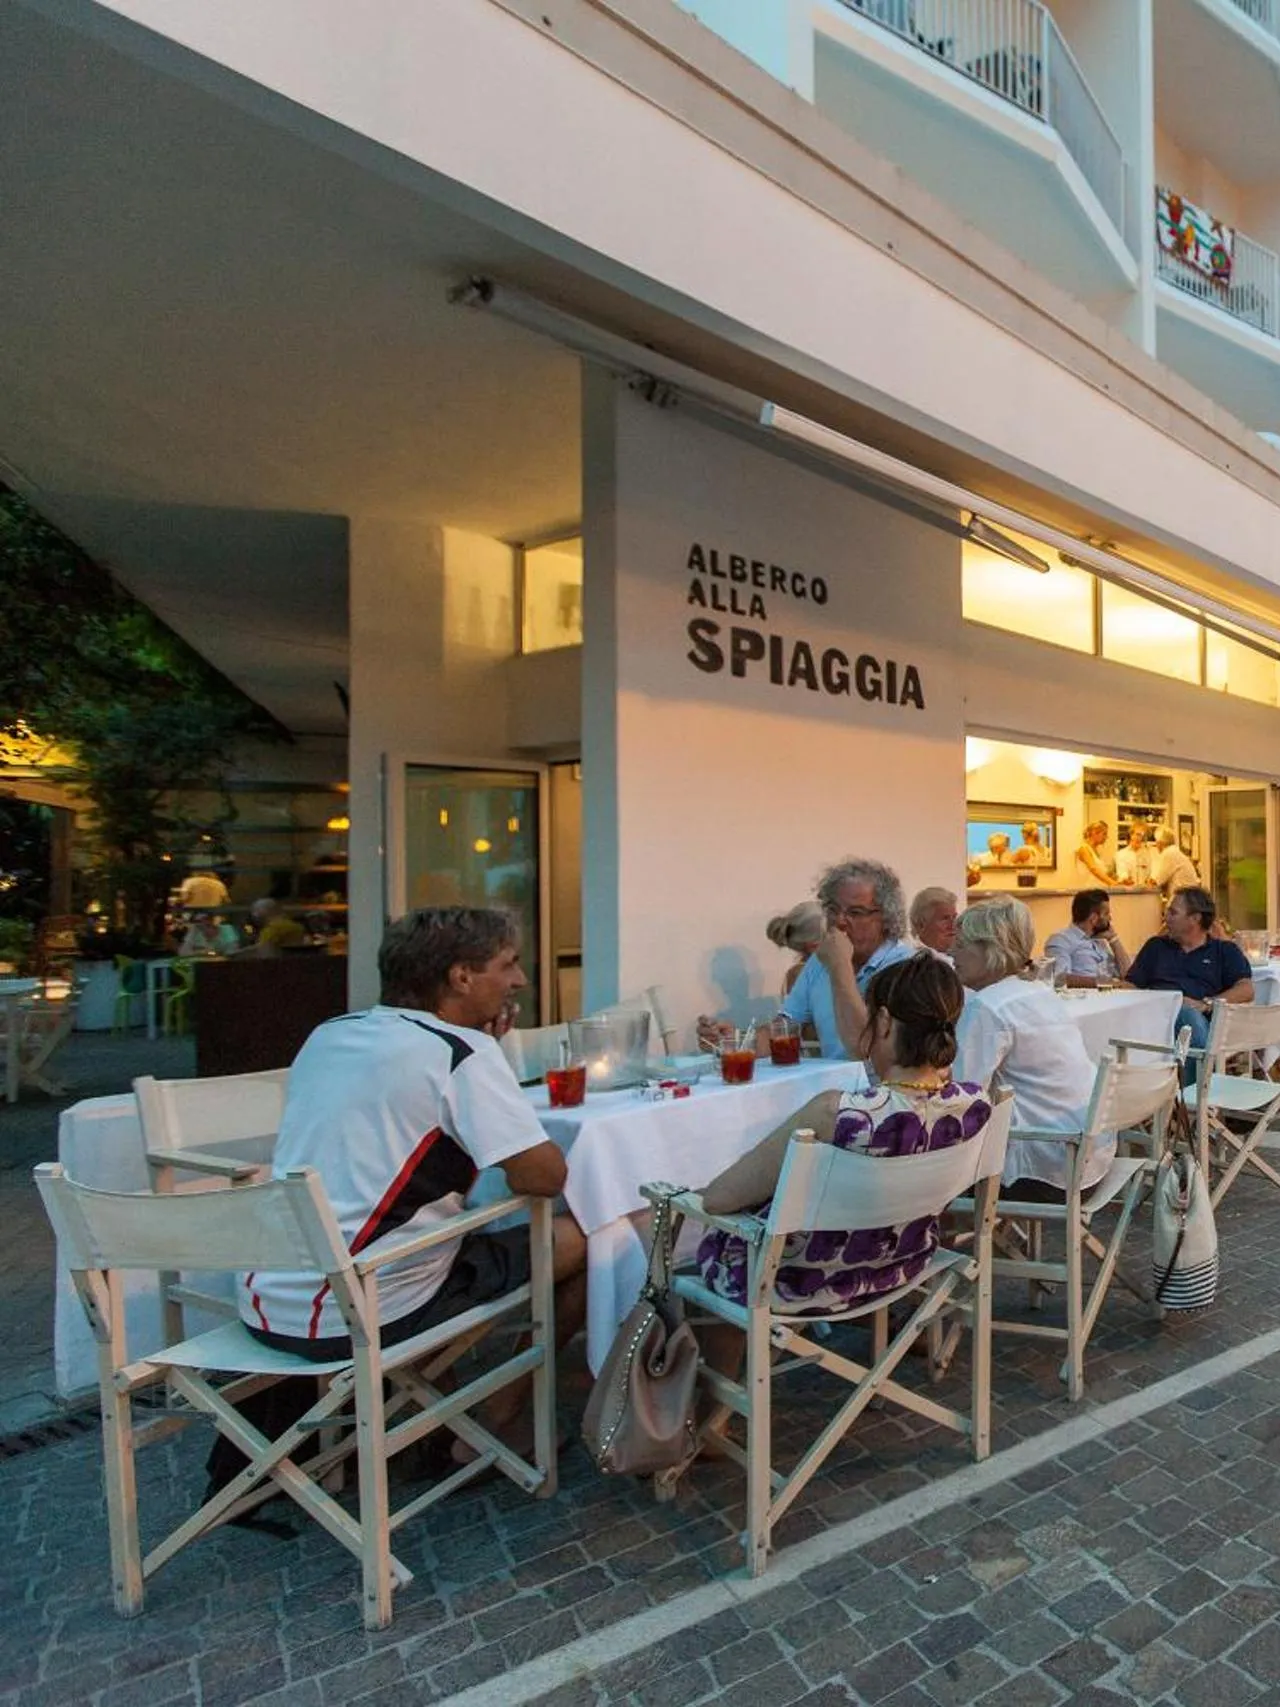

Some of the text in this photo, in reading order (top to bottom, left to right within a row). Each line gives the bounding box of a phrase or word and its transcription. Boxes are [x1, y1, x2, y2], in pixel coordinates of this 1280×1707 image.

[686, 578, 767, 621] ALLA
[687, 542, 829, 605] ALBERGO
[687, 617, 925, 710] SPIAGGIA
